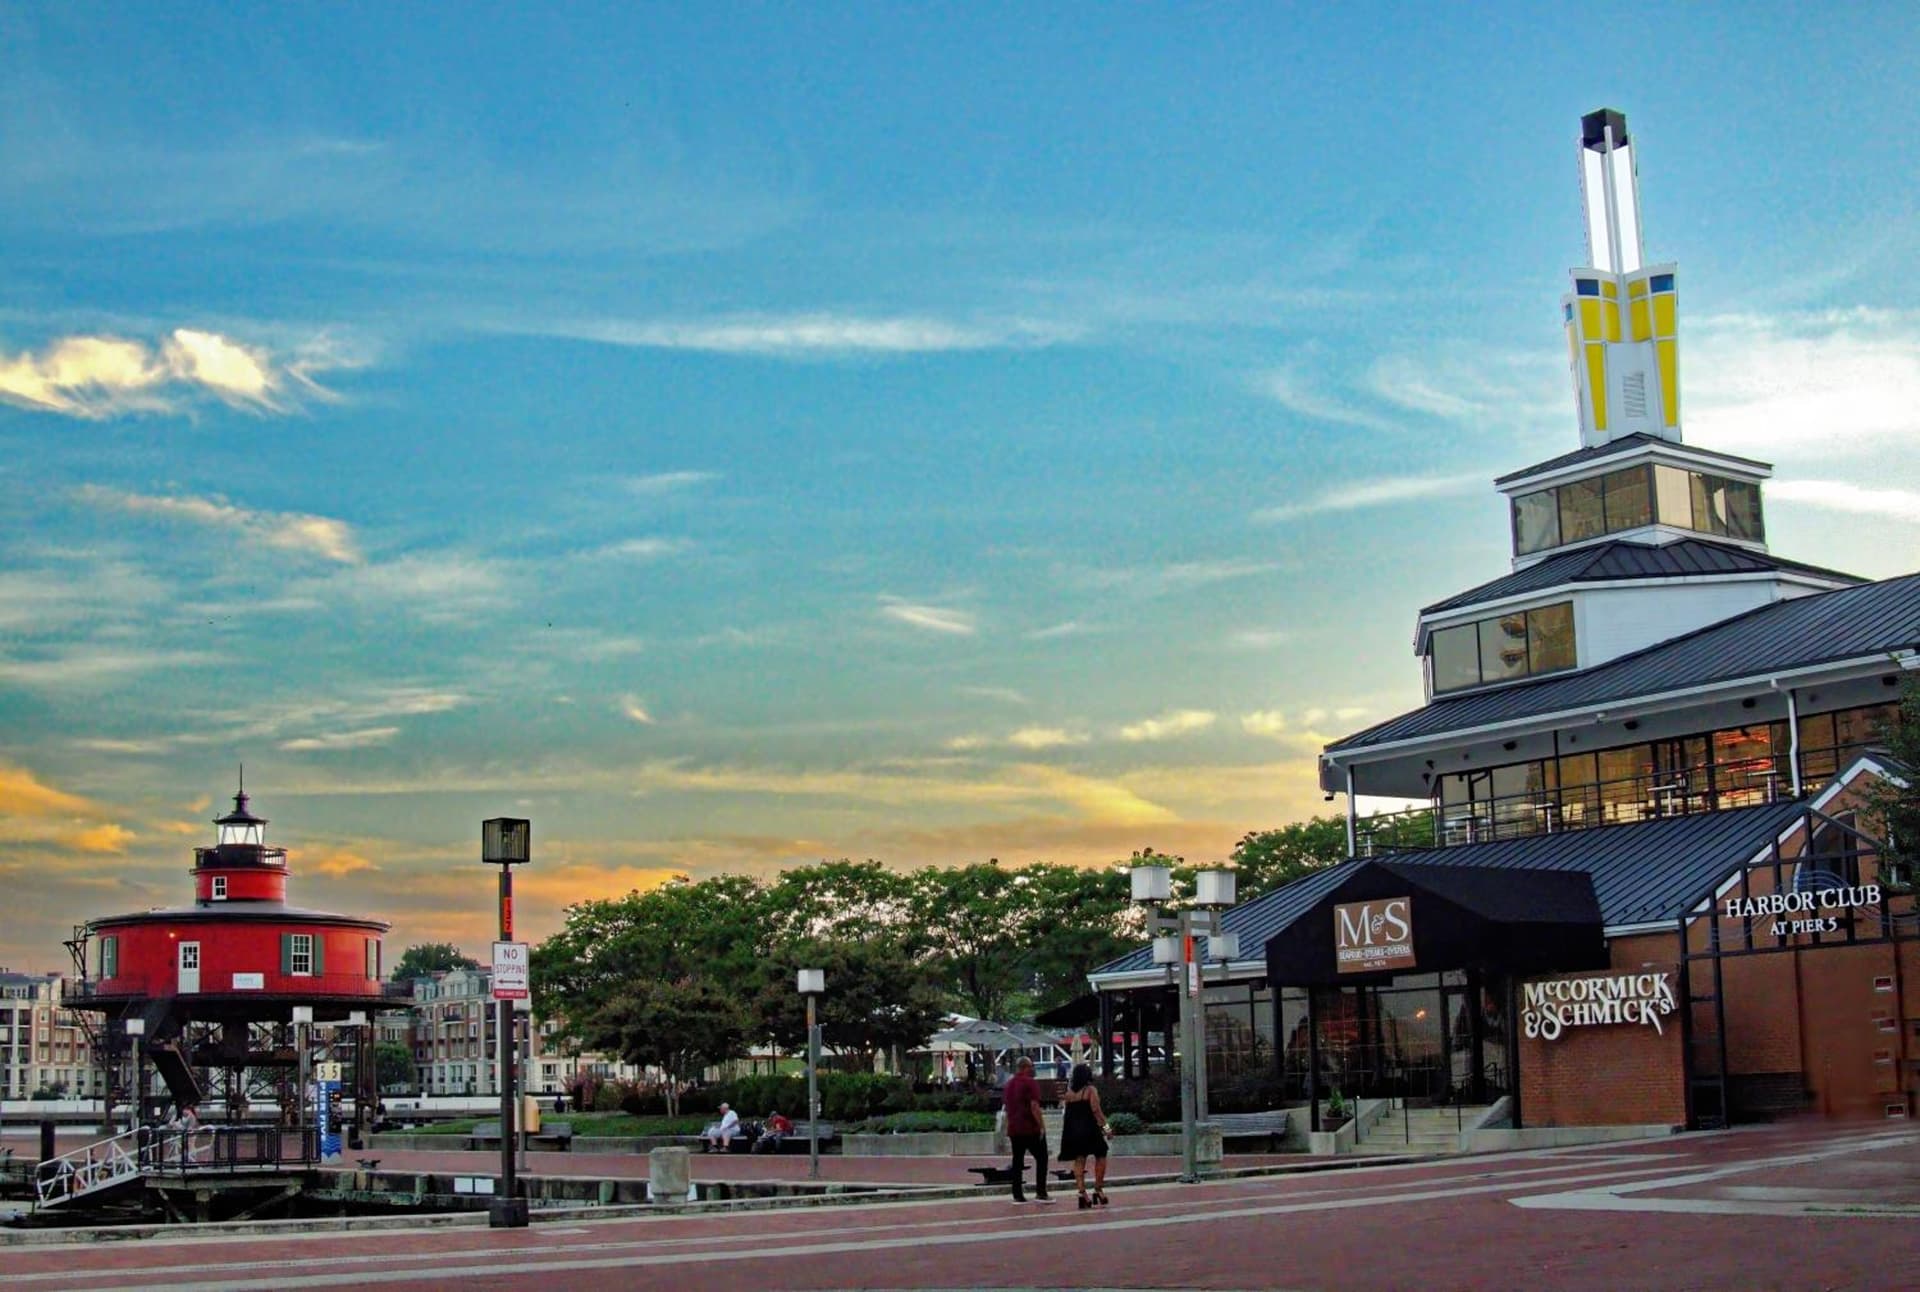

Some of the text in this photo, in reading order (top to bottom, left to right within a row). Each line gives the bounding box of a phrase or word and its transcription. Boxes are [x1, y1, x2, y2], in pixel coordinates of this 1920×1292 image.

[1726, 884, 1881, 917] HARBOR CLUB
[1770, 917, 1837, 936] AT PIER 5
[503, 948, 518, 960] NO
